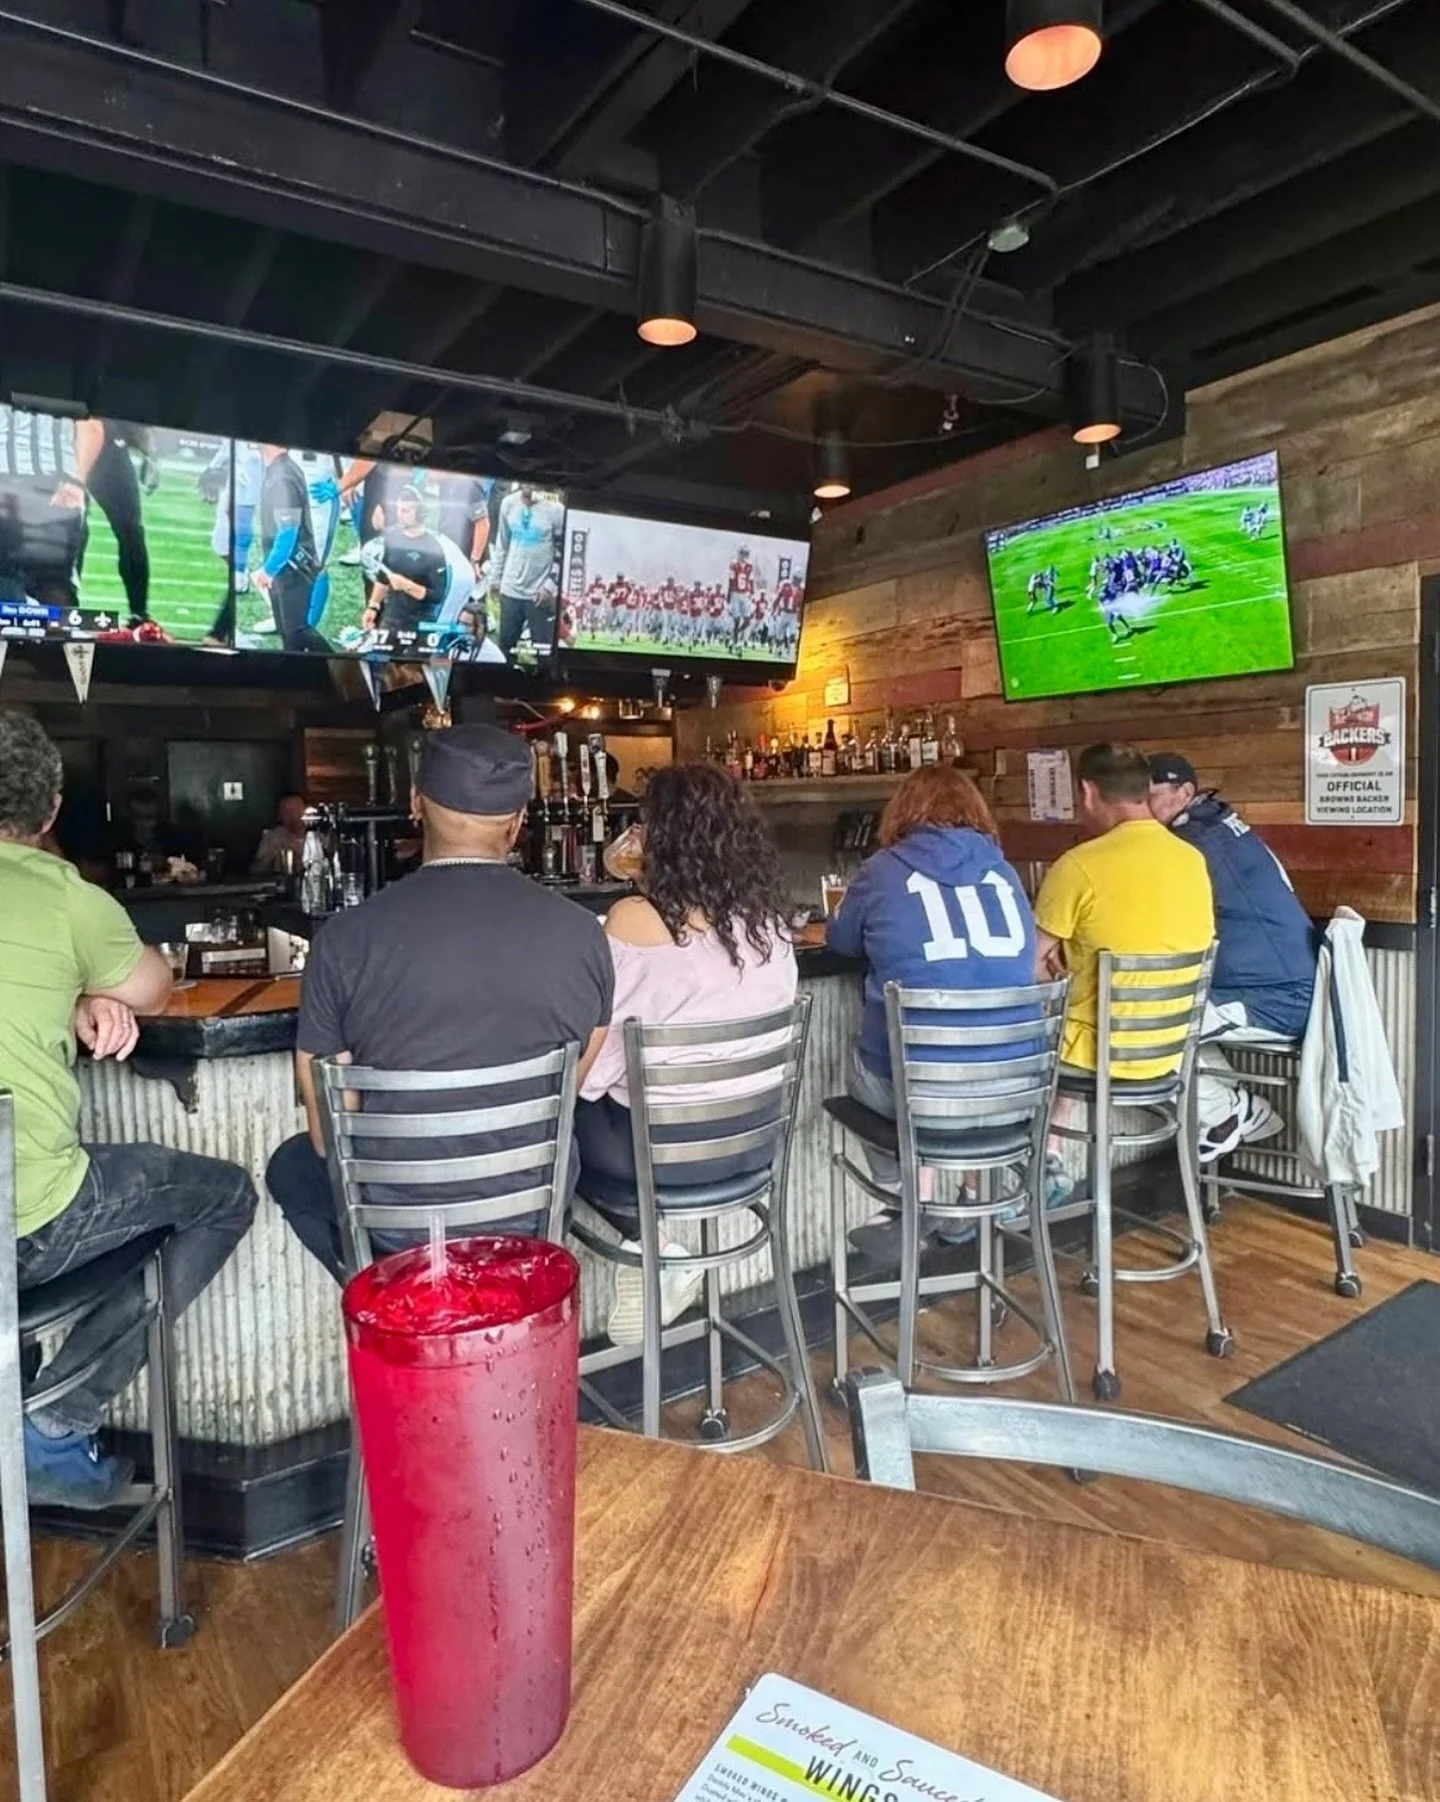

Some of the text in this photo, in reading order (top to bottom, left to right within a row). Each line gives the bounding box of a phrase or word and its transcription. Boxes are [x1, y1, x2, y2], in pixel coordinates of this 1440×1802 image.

[68, 610, 82, 626] 6
[1326, 780, 1383, 792] OFFICIAL
[1319, 795, 1390, 803] BROWNS BACKER
[906, 870, 1025, 962] 10
[755, 1702, 859, 1758] Smoked
[852, 1749, 879, 1769] AND
[713, 1763, 749, 1786] SMOKED
